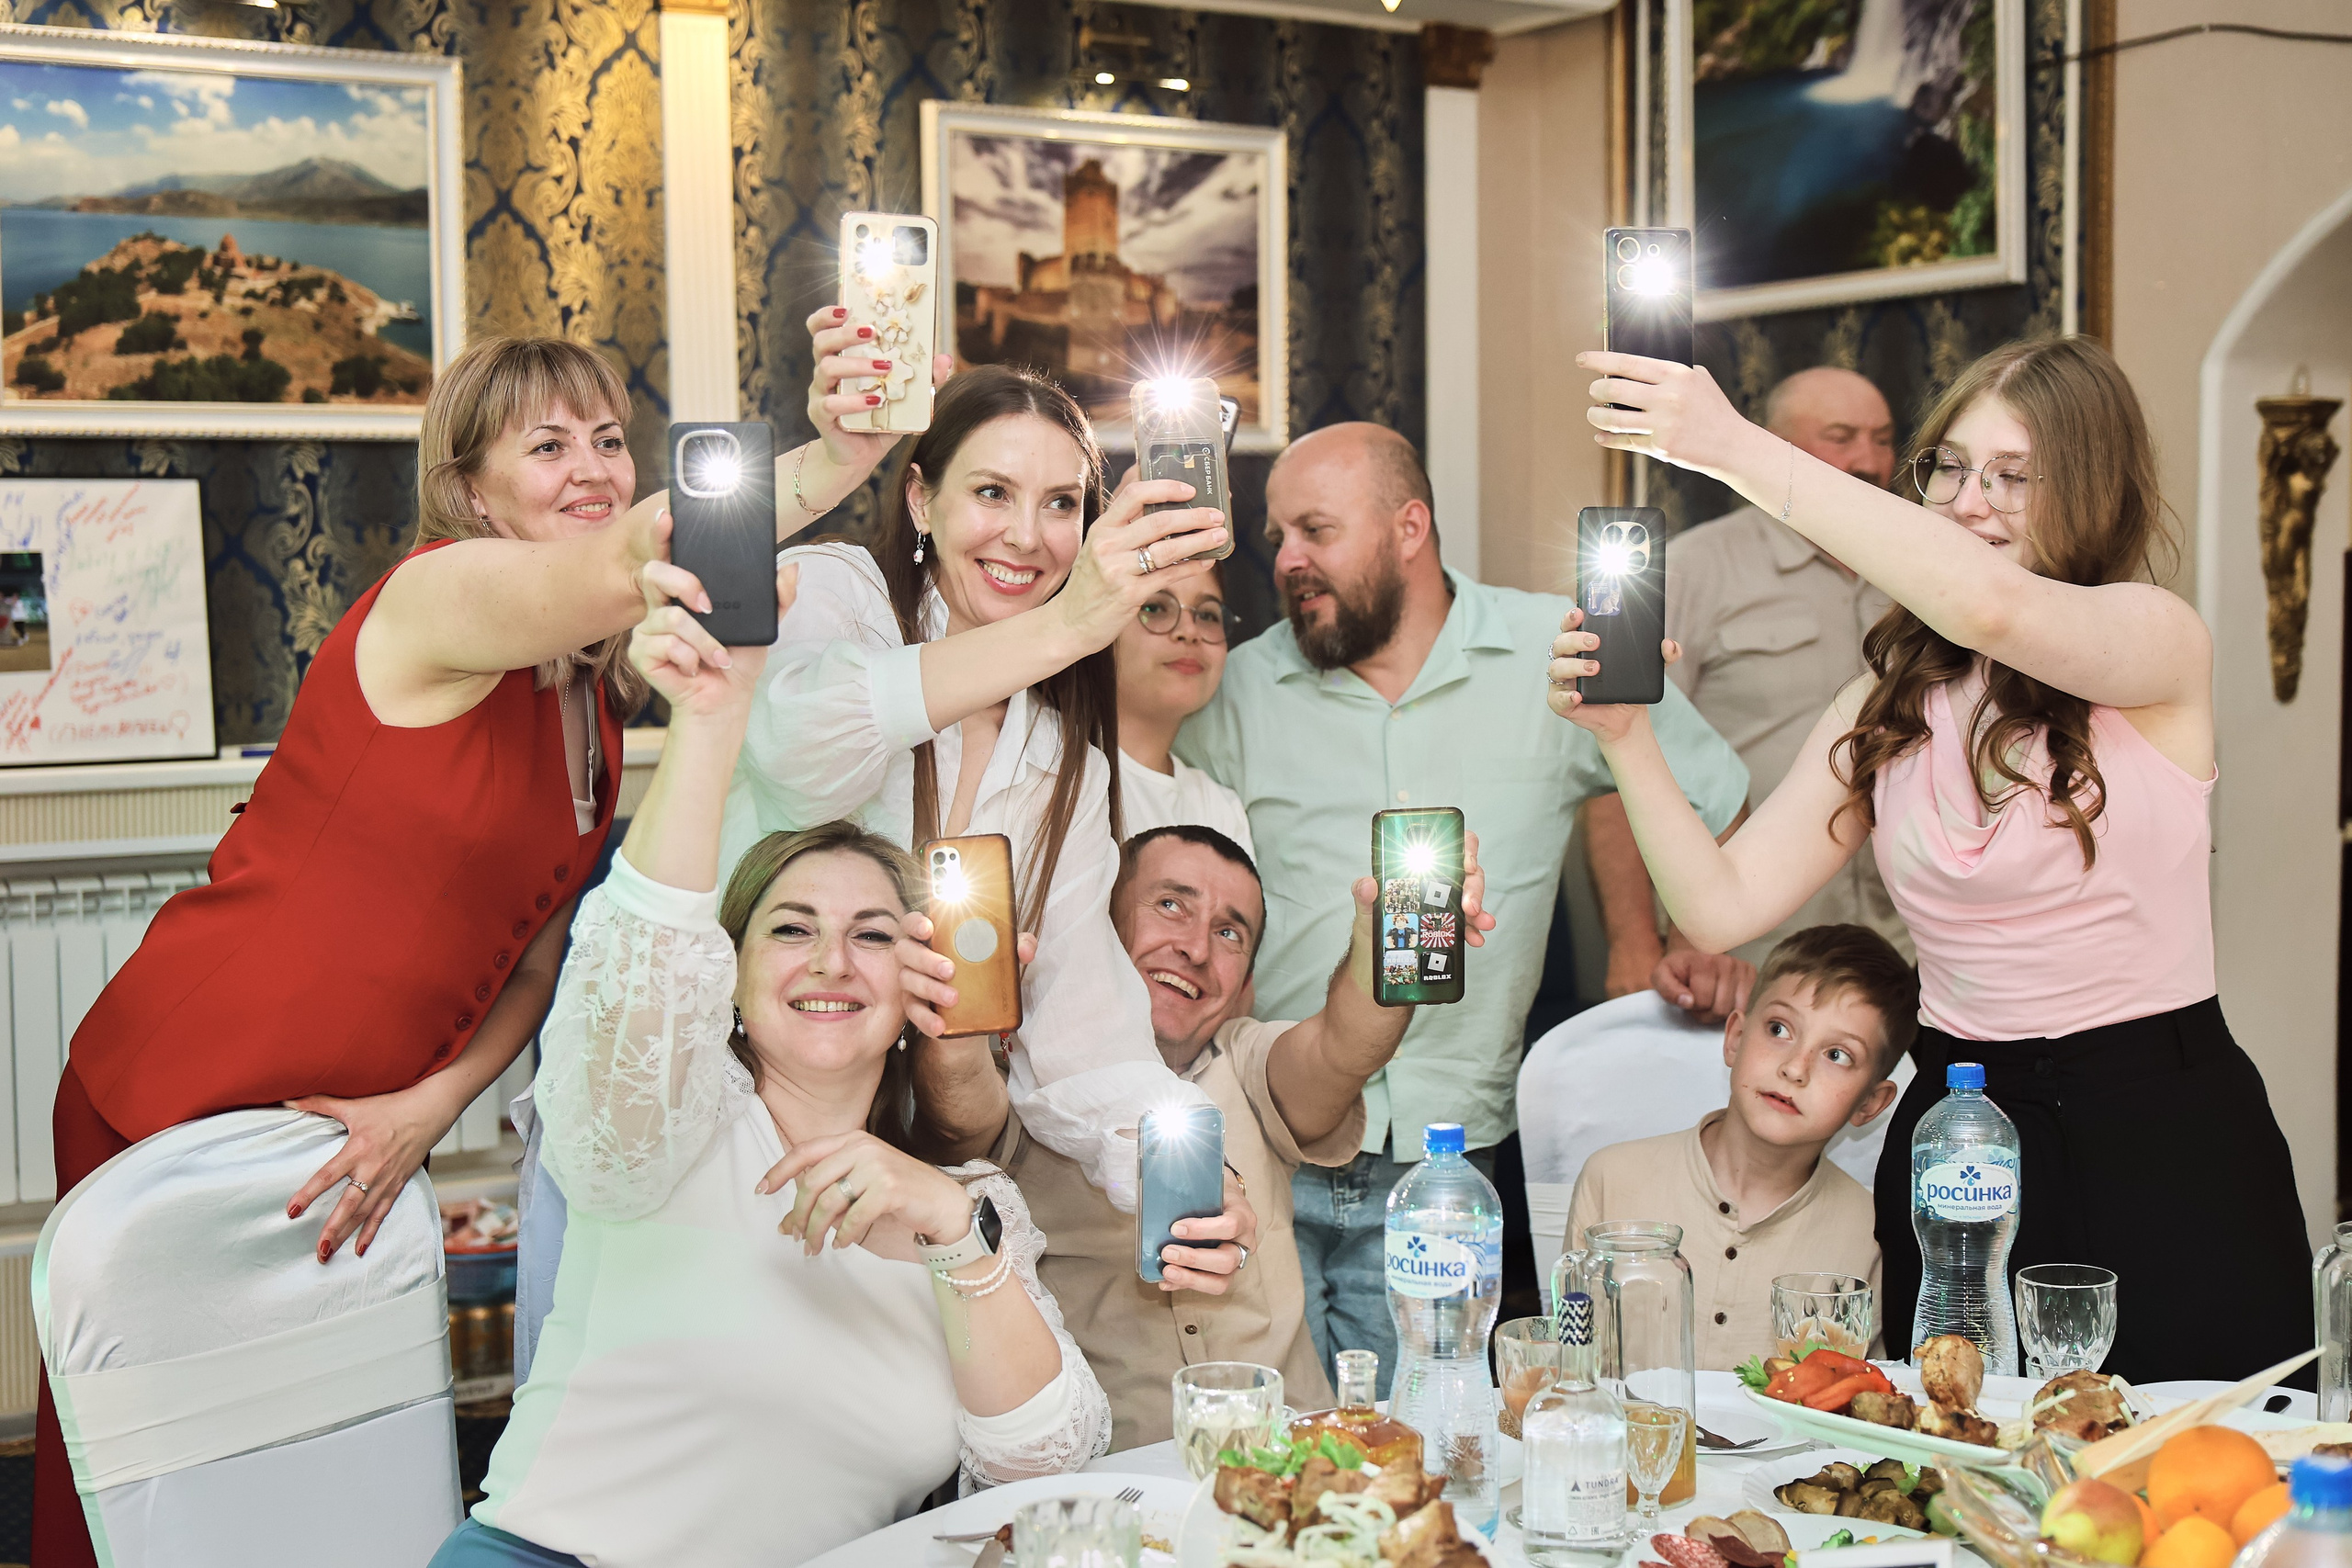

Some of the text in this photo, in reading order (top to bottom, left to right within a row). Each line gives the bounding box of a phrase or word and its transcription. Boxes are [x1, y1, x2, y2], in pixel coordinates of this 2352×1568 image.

[1928, 1183, 2011, 1201] росинка
[1938, 1203, 1985, 1212] минеральная
[1586, 1477, 1619, 1488] TUNDRA
